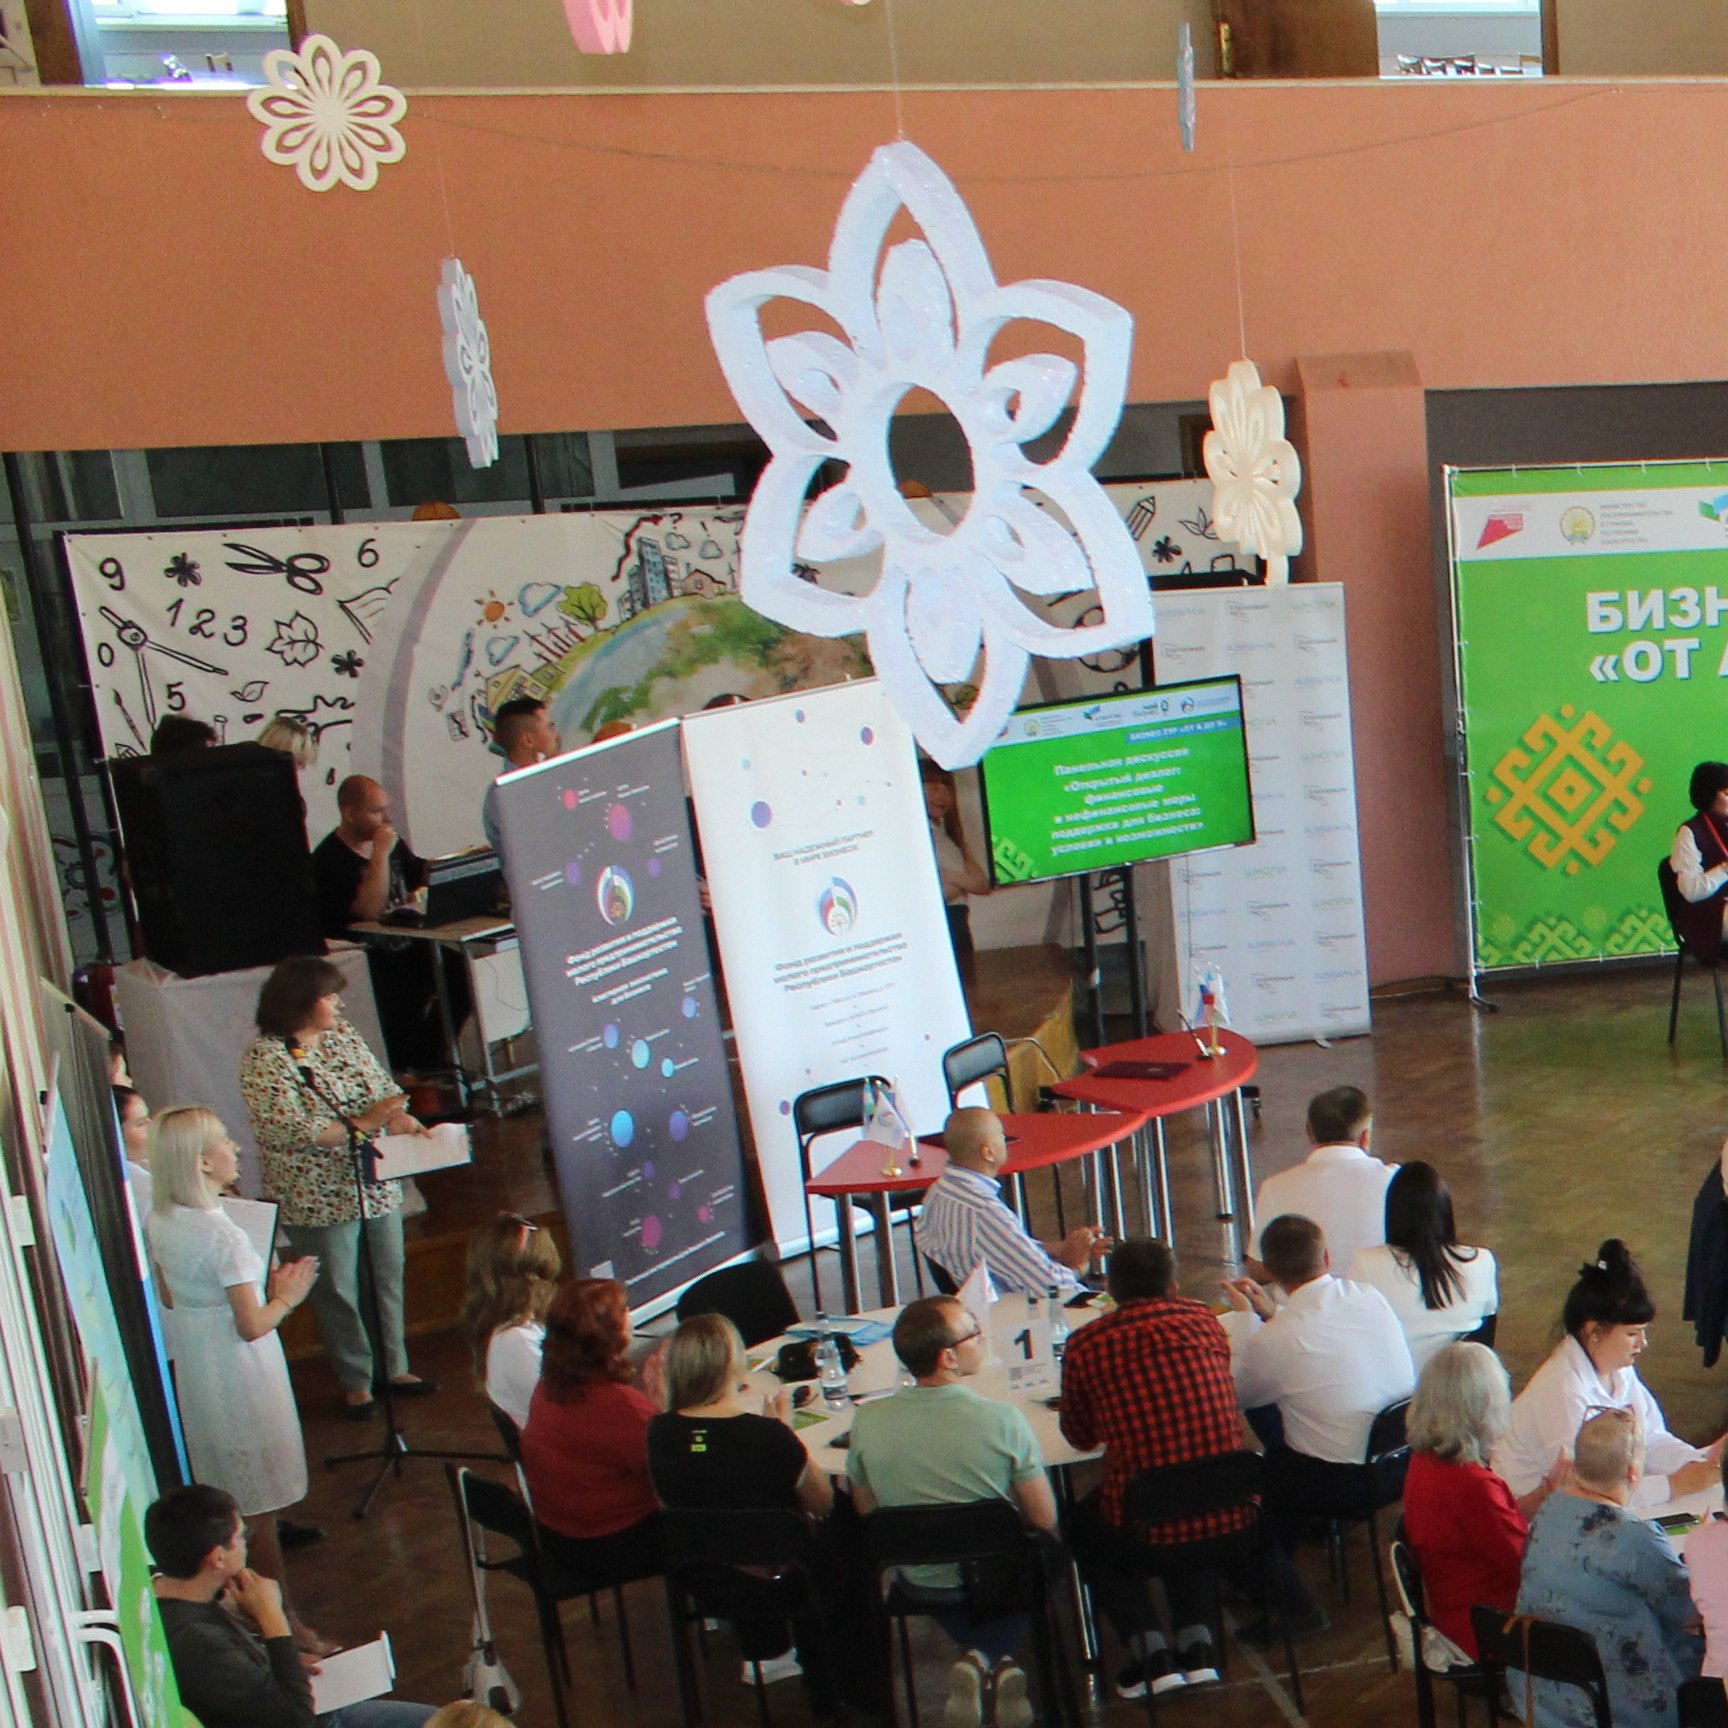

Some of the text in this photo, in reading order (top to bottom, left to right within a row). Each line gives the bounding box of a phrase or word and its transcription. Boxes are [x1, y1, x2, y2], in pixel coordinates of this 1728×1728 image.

[358, 538, 379, 568] 6
[100, 557, 126, 591] 9
[1588, 636, 1701, 683] «ОТ
[167, 681, 186, 711] 5
[1013, 1328, 1034, 1360] 1
